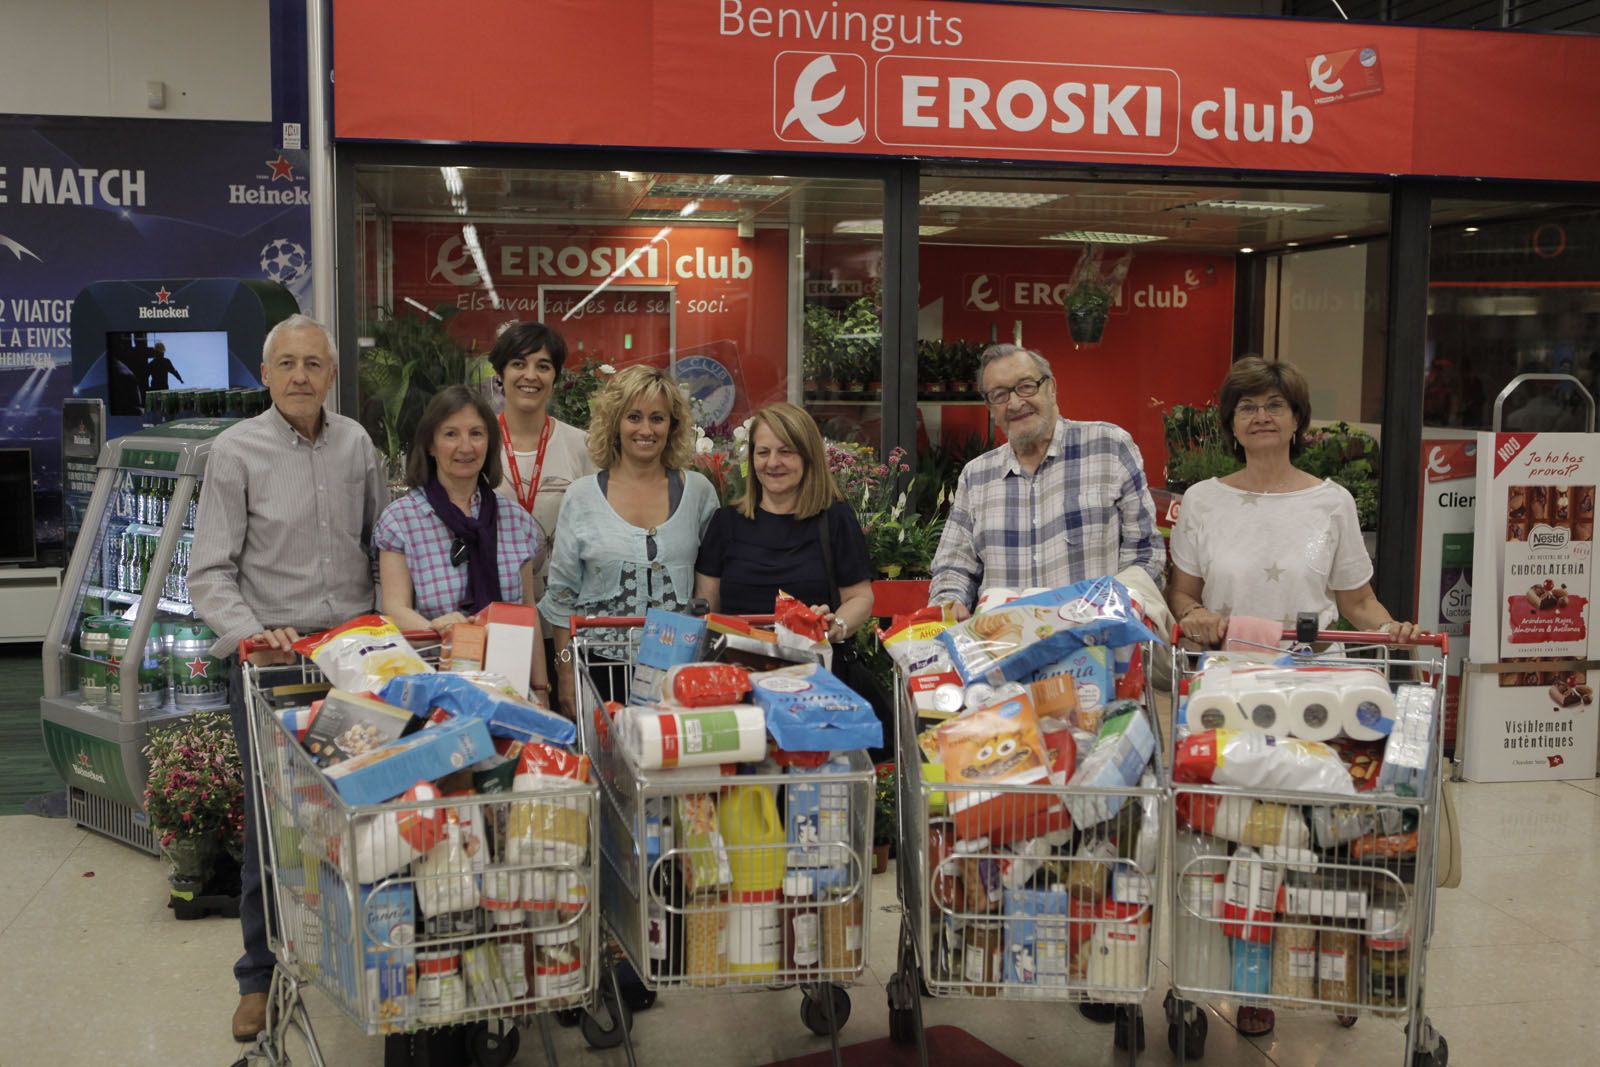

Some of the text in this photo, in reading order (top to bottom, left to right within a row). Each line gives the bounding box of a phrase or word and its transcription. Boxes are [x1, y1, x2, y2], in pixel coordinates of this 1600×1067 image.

[719, 0, 963, 52] Benvinguts
[901, 75, 1314, 144] EROSKI club
[20, 166, 146, 206] MATCH
[501, 246, 753, 279] EROSKI club
[456, 293, 485, 311] Els
[614, 295, 638, 312] de
[1134, 285, 1188, 308] club
[139, 306, 188, 318] Heineken
[10, 328, 22, 347] A
[1497, 436, 1521, 462] NOU
[1545, 451, 1559, 463] ho
[1562, 452, 1585, 463] has
[1533, 533, 1565, 543] Nestlé
[1511, 563, 1584, 575] CHOCOLATERÍA
[1505, 719, 1573, 733] Visiblement
